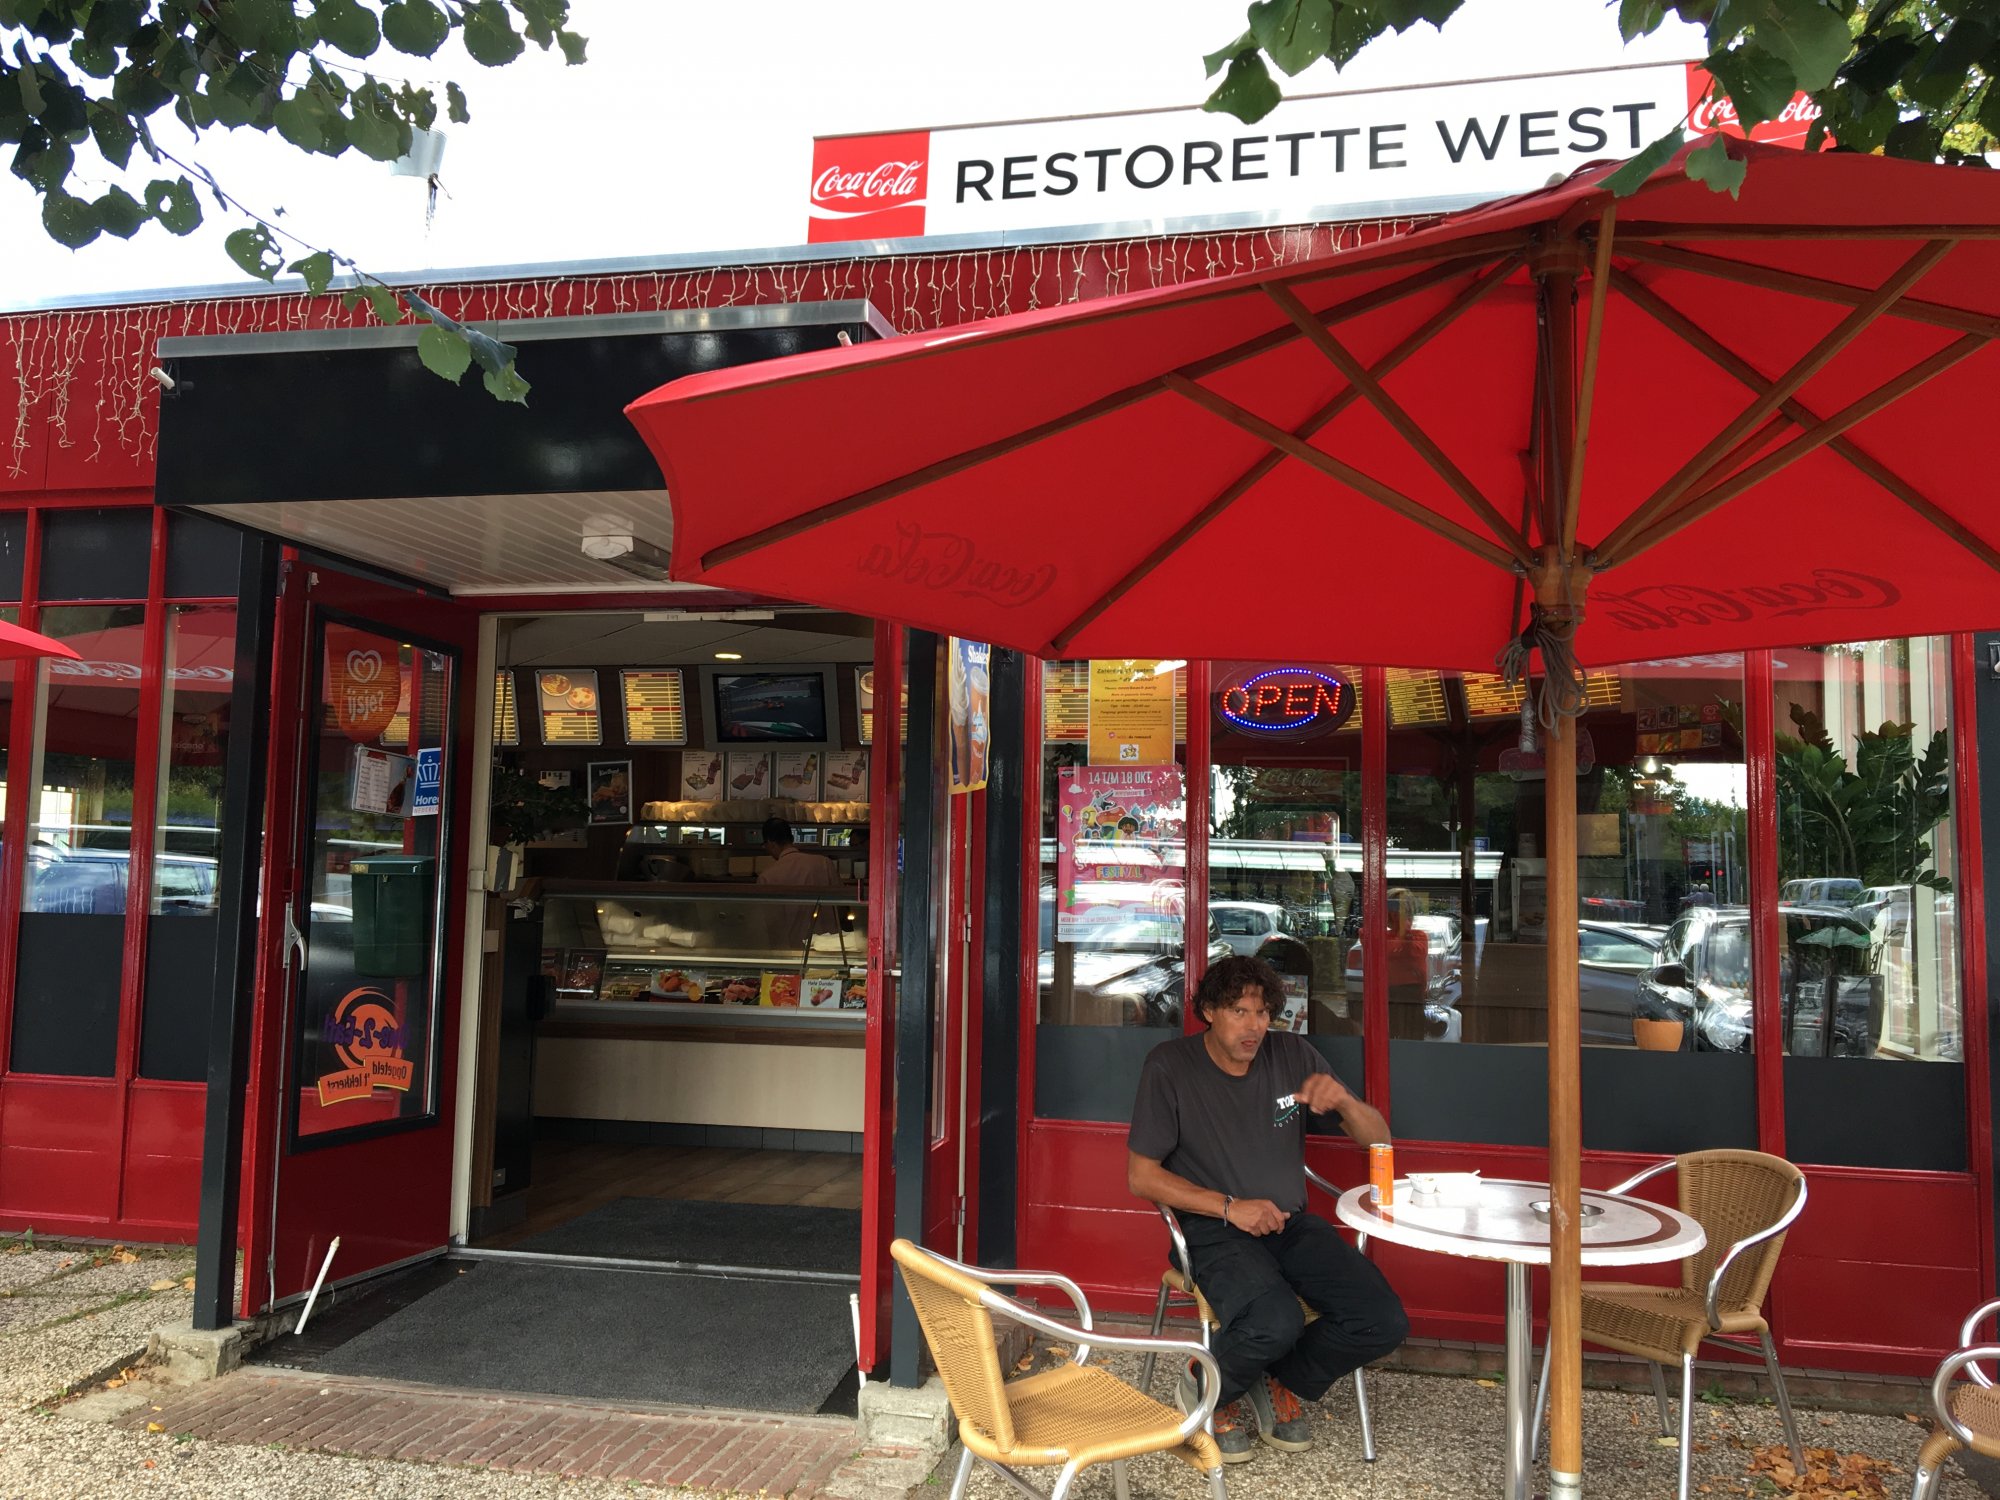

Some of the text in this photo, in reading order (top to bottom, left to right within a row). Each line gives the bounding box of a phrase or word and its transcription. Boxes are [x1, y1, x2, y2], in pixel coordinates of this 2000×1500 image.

[955, 101, 1658, 205] RESTORETTE WEST
[811, 160, 926, 204] Coca-Cola
[1222, 683, 1342, 717] OPEN
[1088, 771, 1100, 785] 14
[1121, 771, 1132, 784] 18
[1096, 866, 1143, 878] FESTIVAL
